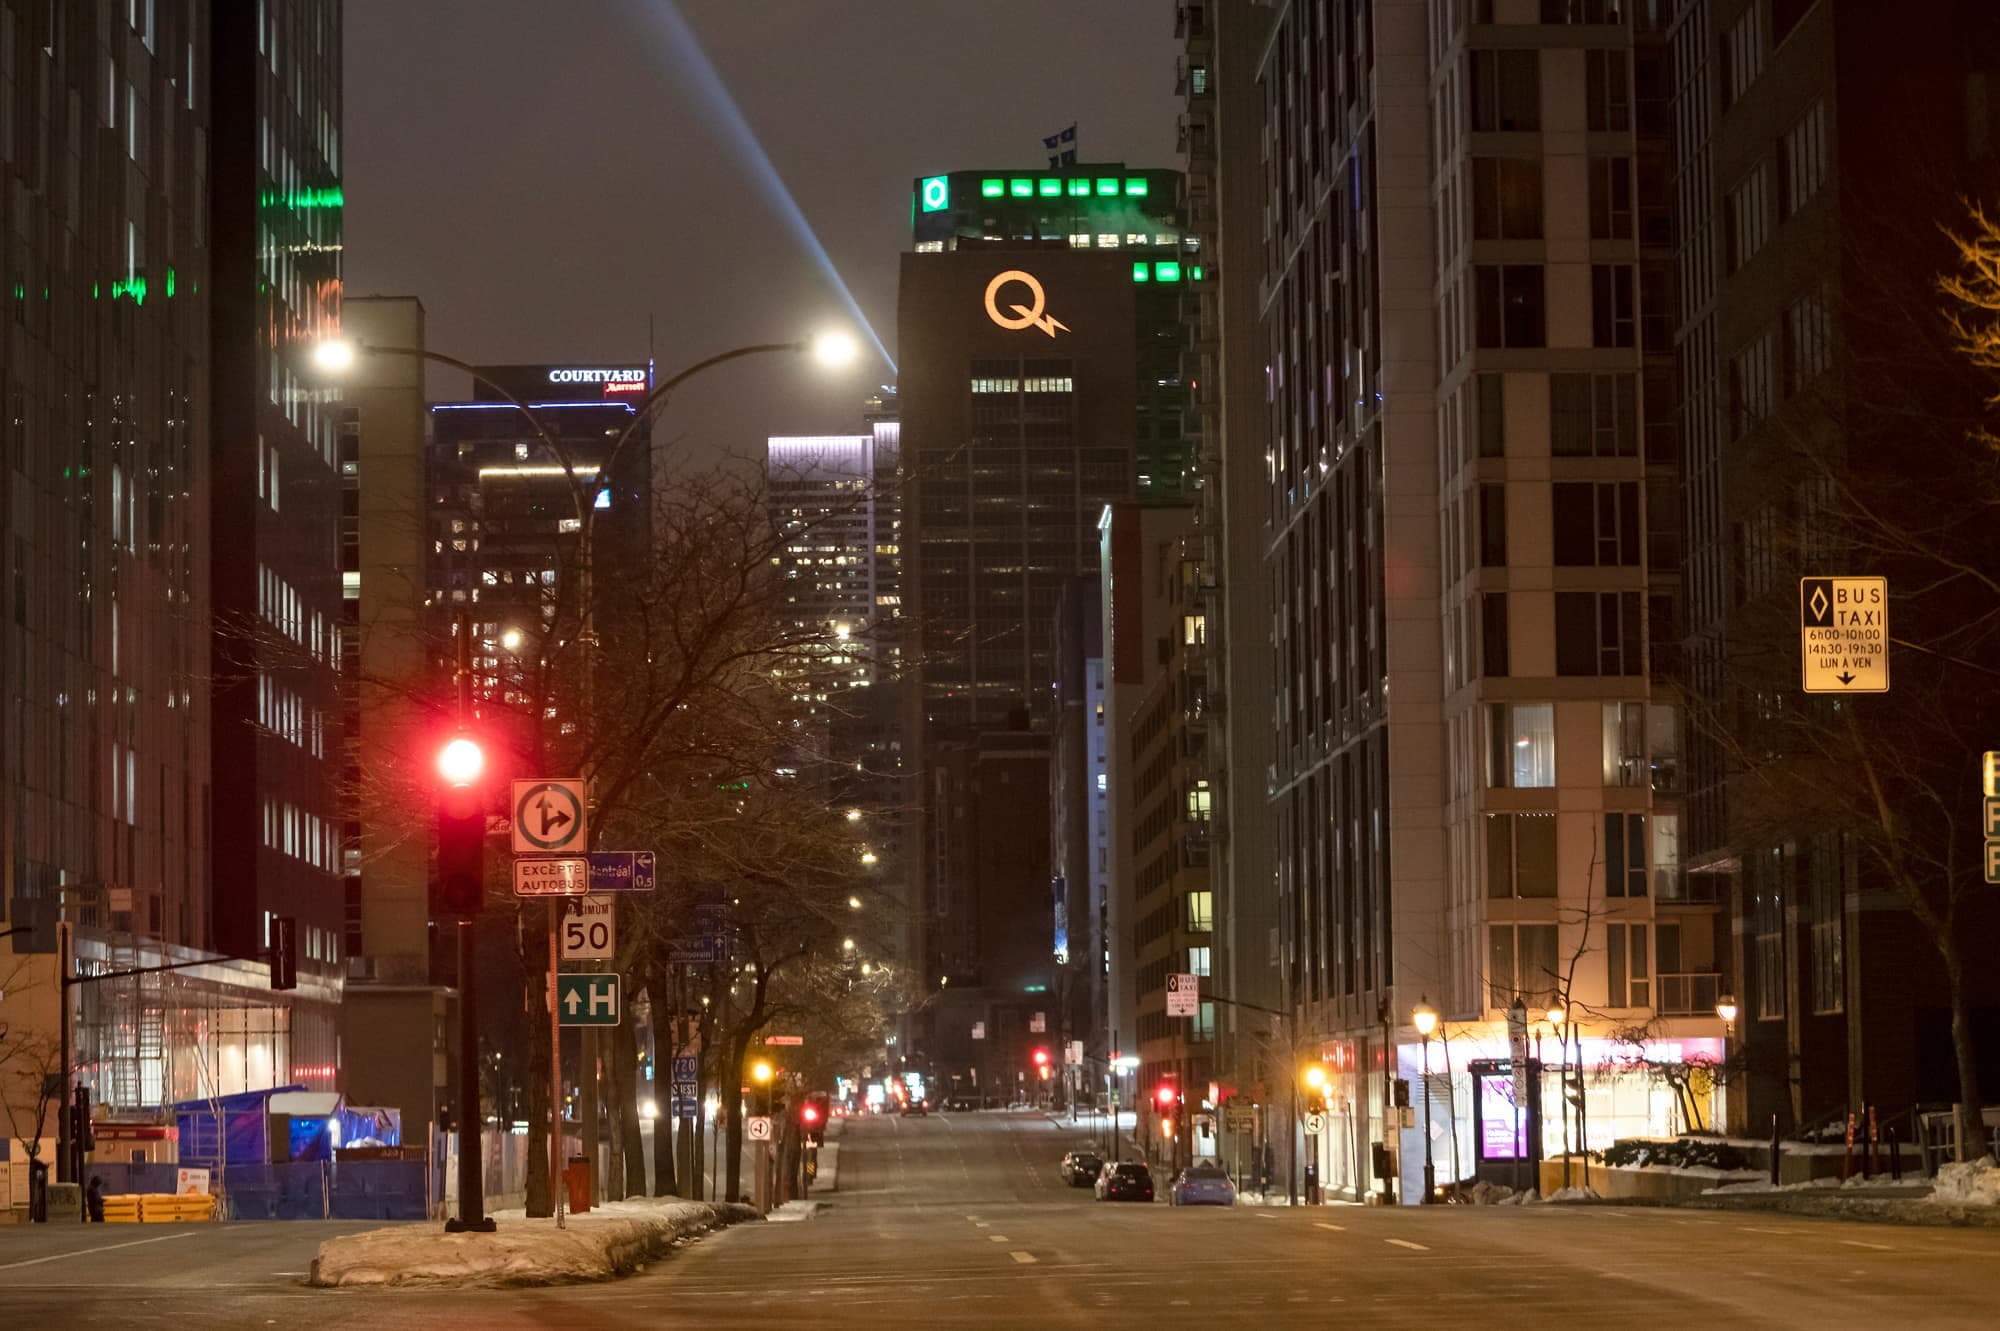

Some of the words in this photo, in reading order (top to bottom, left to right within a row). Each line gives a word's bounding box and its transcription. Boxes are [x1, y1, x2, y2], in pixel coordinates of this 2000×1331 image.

[549, 369, 646, 383] COURTYARD
[1837, 587, 1880, 604] BUS
[1837, 610, 1881, 626] TAXI
[1820, 658, 1838, 669] LUN
[1852, 657, 1872, 669] VEN
[521, 879, 585, 890] AUTOBUS
[567, 903, 609, 915] MIMUM
[567, 922, 609, 950] 50
[589, 983, 616, 1016] H
